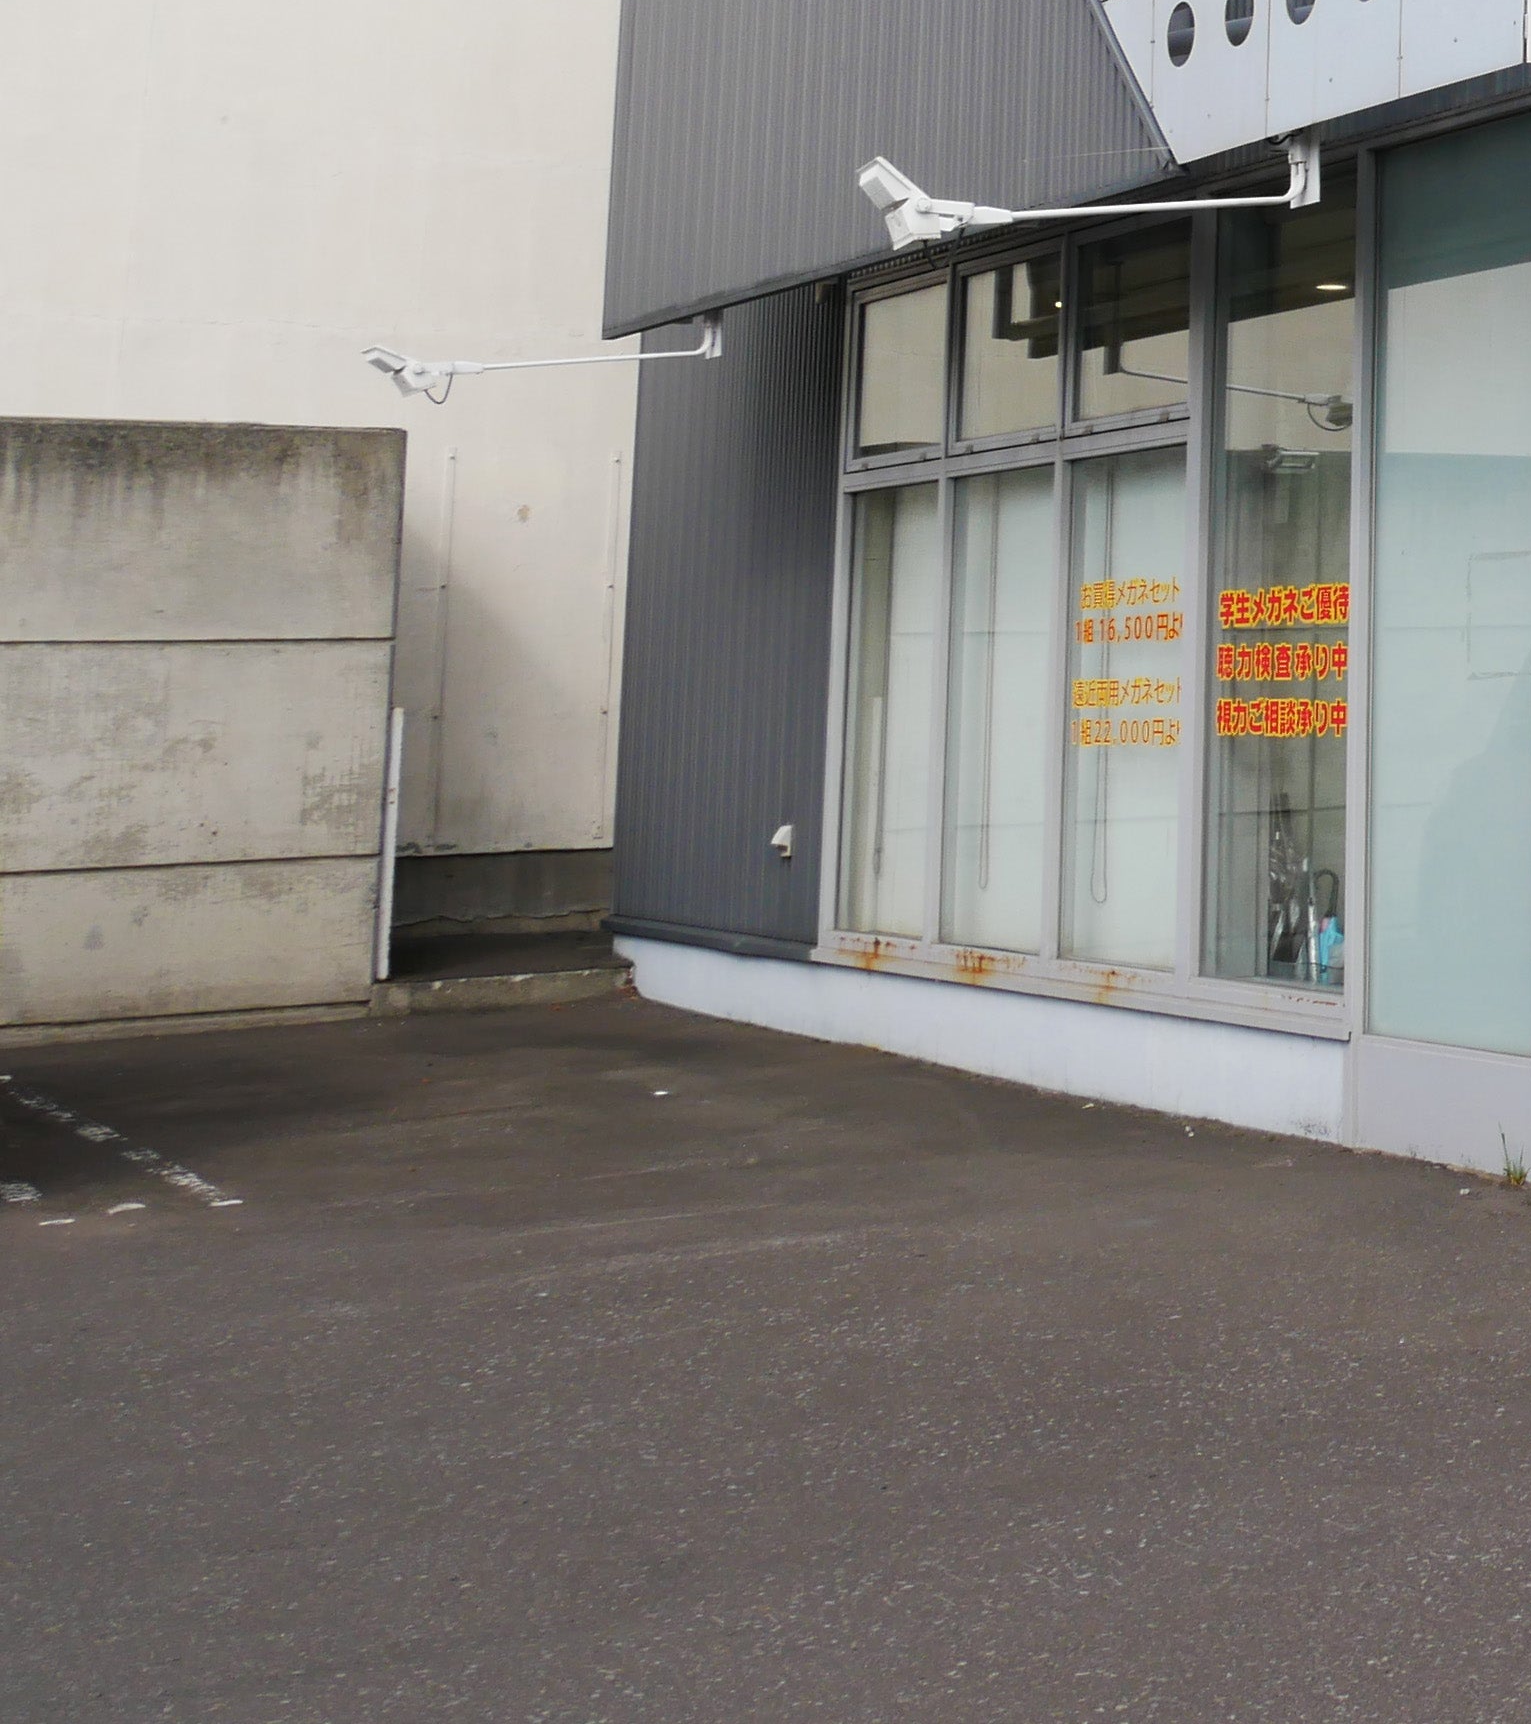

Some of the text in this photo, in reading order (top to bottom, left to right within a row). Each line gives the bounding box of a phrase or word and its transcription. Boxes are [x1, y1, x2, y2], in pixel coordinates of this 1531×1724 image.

[1080, 577, 1180, 610] お買得メガネセット
[1219, 583, 1349, 628] 学生メガネご優待
[1216, 641, 1348, 681] 聴力検査承り中
[1216, 697, 1348, 737] 視力ご相談承り中
